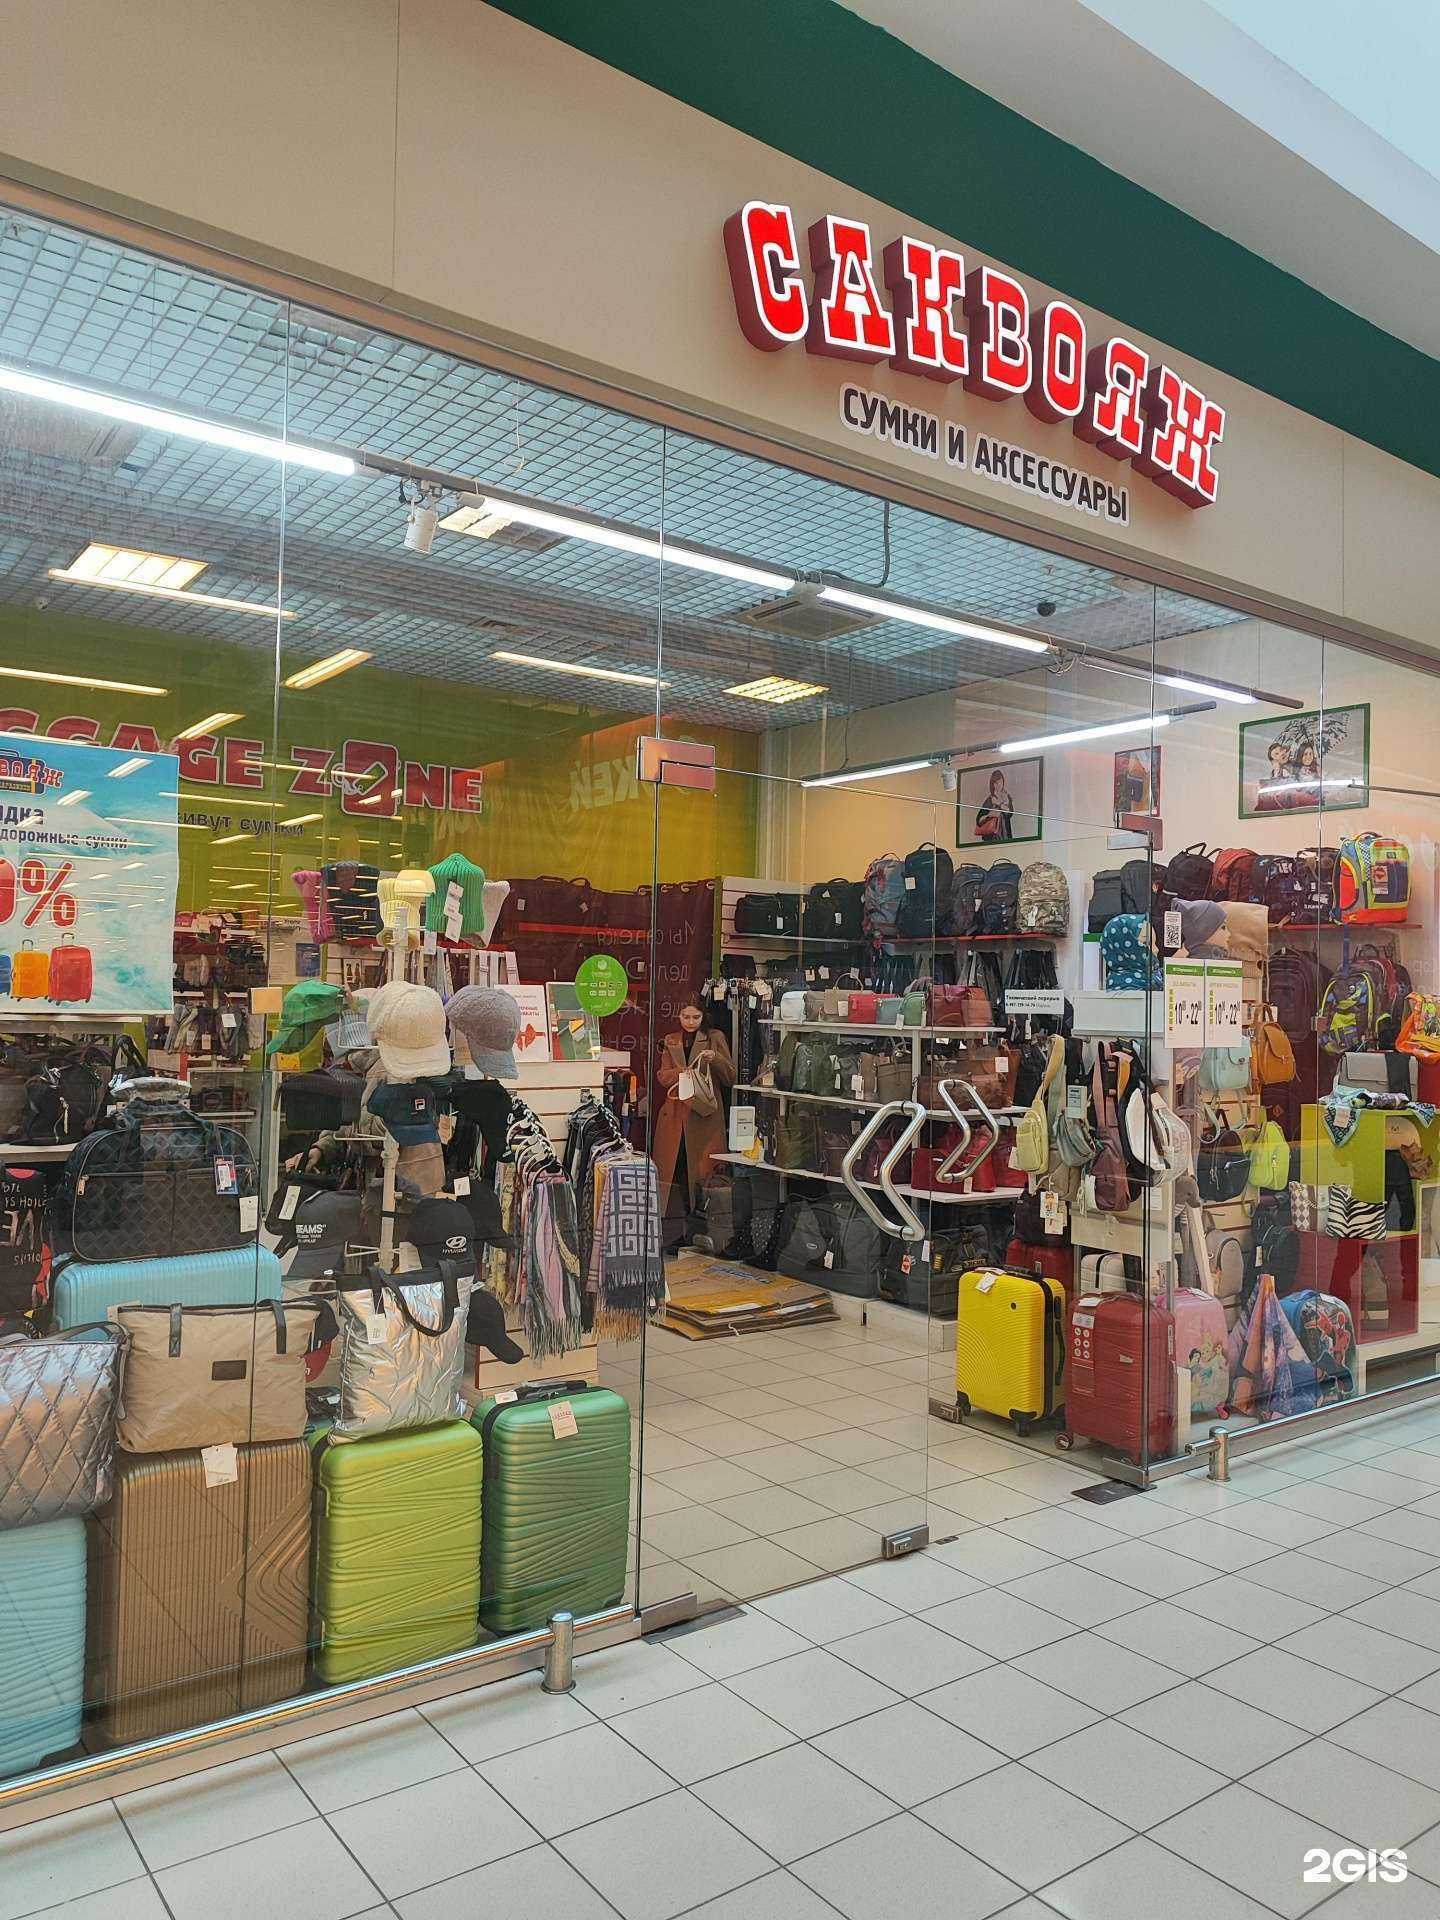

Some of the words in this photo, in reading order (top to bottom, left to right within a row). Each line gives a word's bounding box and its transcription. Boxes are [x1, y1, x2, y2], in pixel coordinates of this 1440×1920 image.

[741, 201, 1226, 503] САКВОЯЖ
[843, 388, 938, 454] СУМКИ
[947, 427, 966, 463] И
[975, 438, 1128, 522] АКСЕССУАРЫ
[85, 833, 129, 849] сумки
[240, 817, 305, 836] сумки
